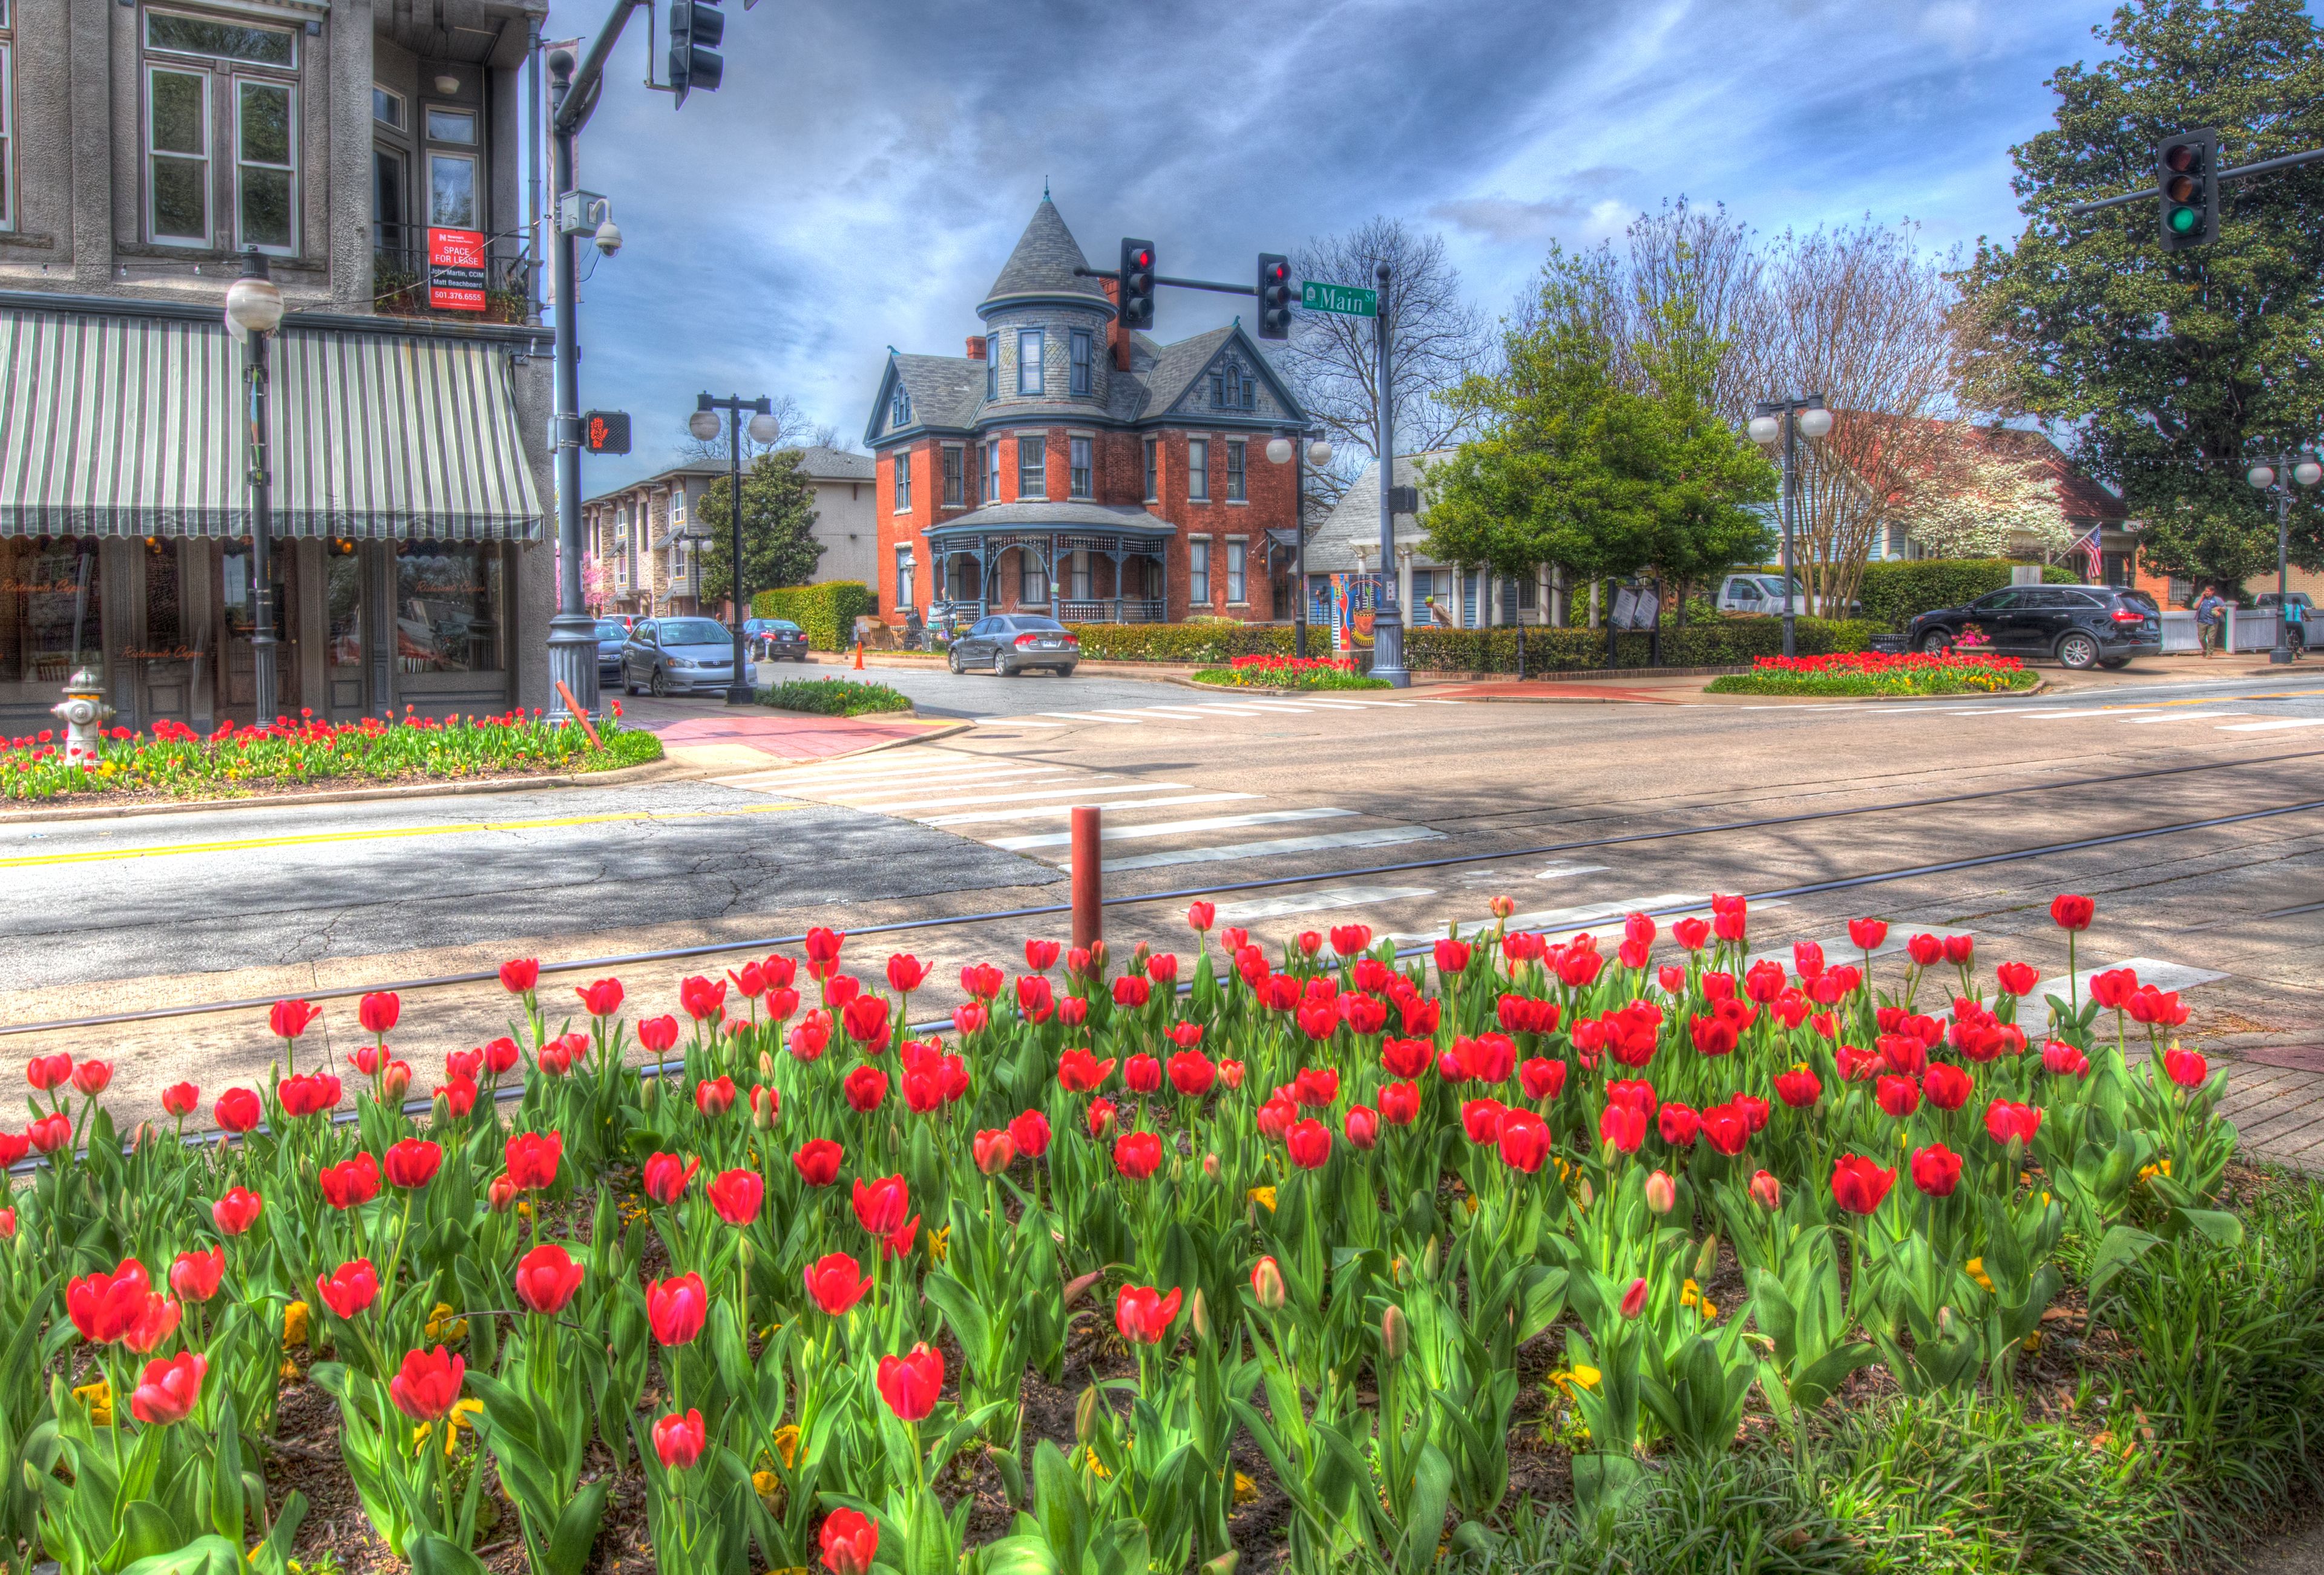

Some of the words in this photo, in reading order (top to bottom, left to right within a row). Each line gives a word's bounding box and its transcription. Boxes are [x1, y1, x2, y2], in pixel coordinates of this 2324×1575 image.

[444, 246, 470, 256] SPACE
[436, 254, 451, 263] FOR
[454, 256, 478, 266] LEASE
[448, 280, 482, 288] Beachboard
[435, 291, 482, 301] 501.376.6555
[1320, 287, 1362, 312] Main
[1365, 291, 1374, 303] St
[121, 646, 170, 659] Ristorante
